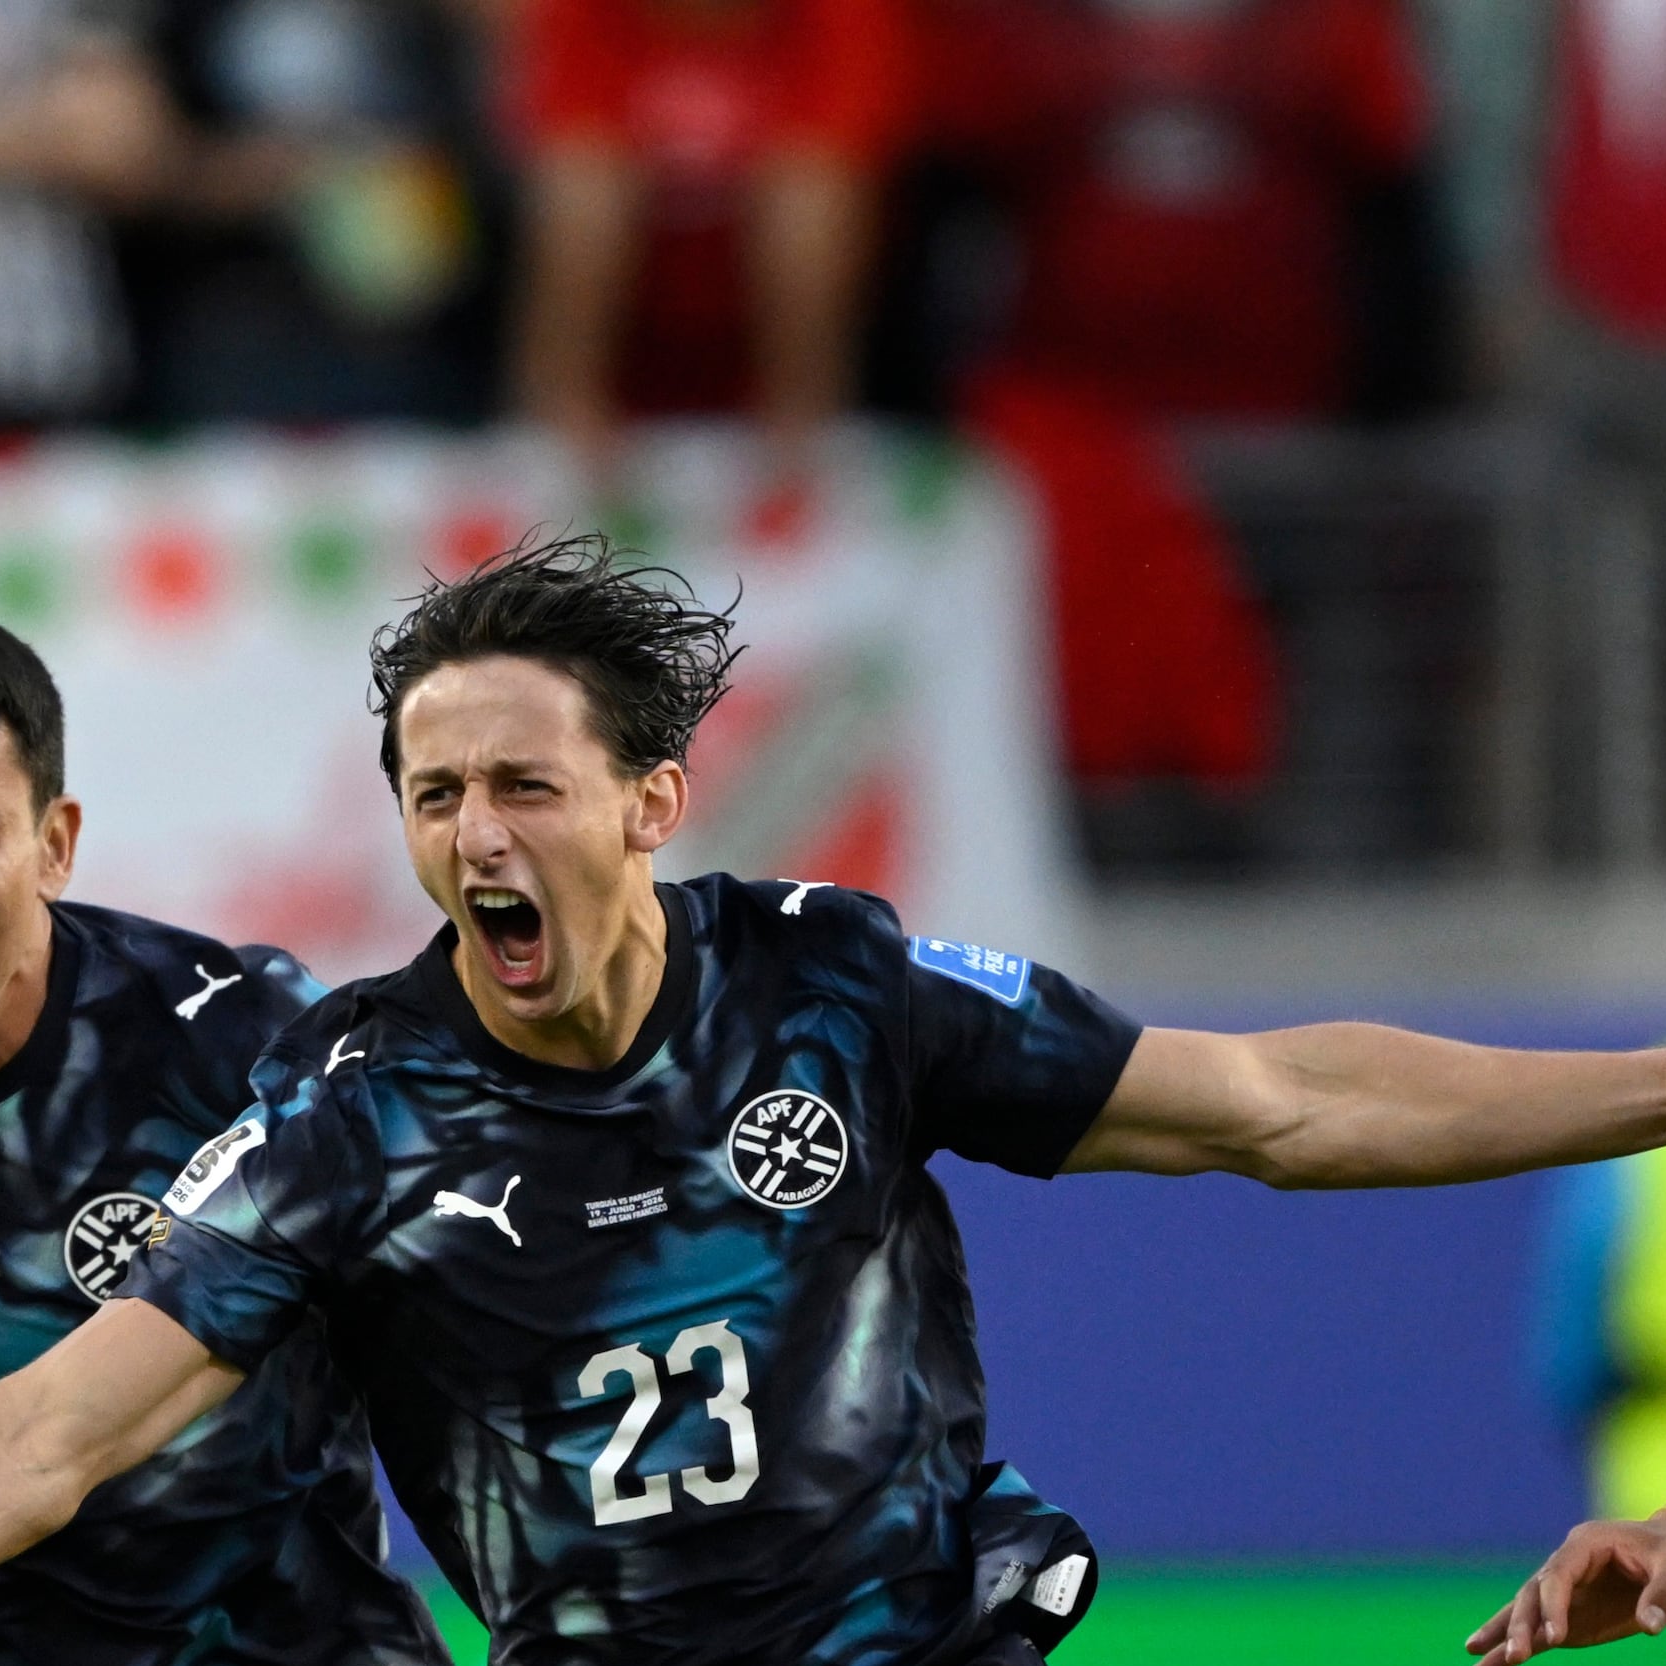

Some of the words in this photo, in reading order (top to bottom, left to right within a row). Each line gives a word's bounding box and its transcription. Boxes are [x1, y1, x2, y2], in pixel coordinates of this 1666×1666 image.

[757, 1097, 793, 1127] APF
[617, 1197, 628, 1206] VS
[628, 1187, 664, 1203] PARAGUAY
[776, 1176, 827, 1202] PARAGUAY
[102, 1203, 141, 1223] APF
[590, 1209, 601, 1219] 19
[608, 1203, 635, 1216] JUNIO
[642, 1195, 664, 1208] 2026
[608, 1214, 618, 1225] DE
[618, 1212, 632, 1223] SAN
[632, 1202, 669, 1220] FRANCISCO
[577, 1318, 760, 1526] 23
